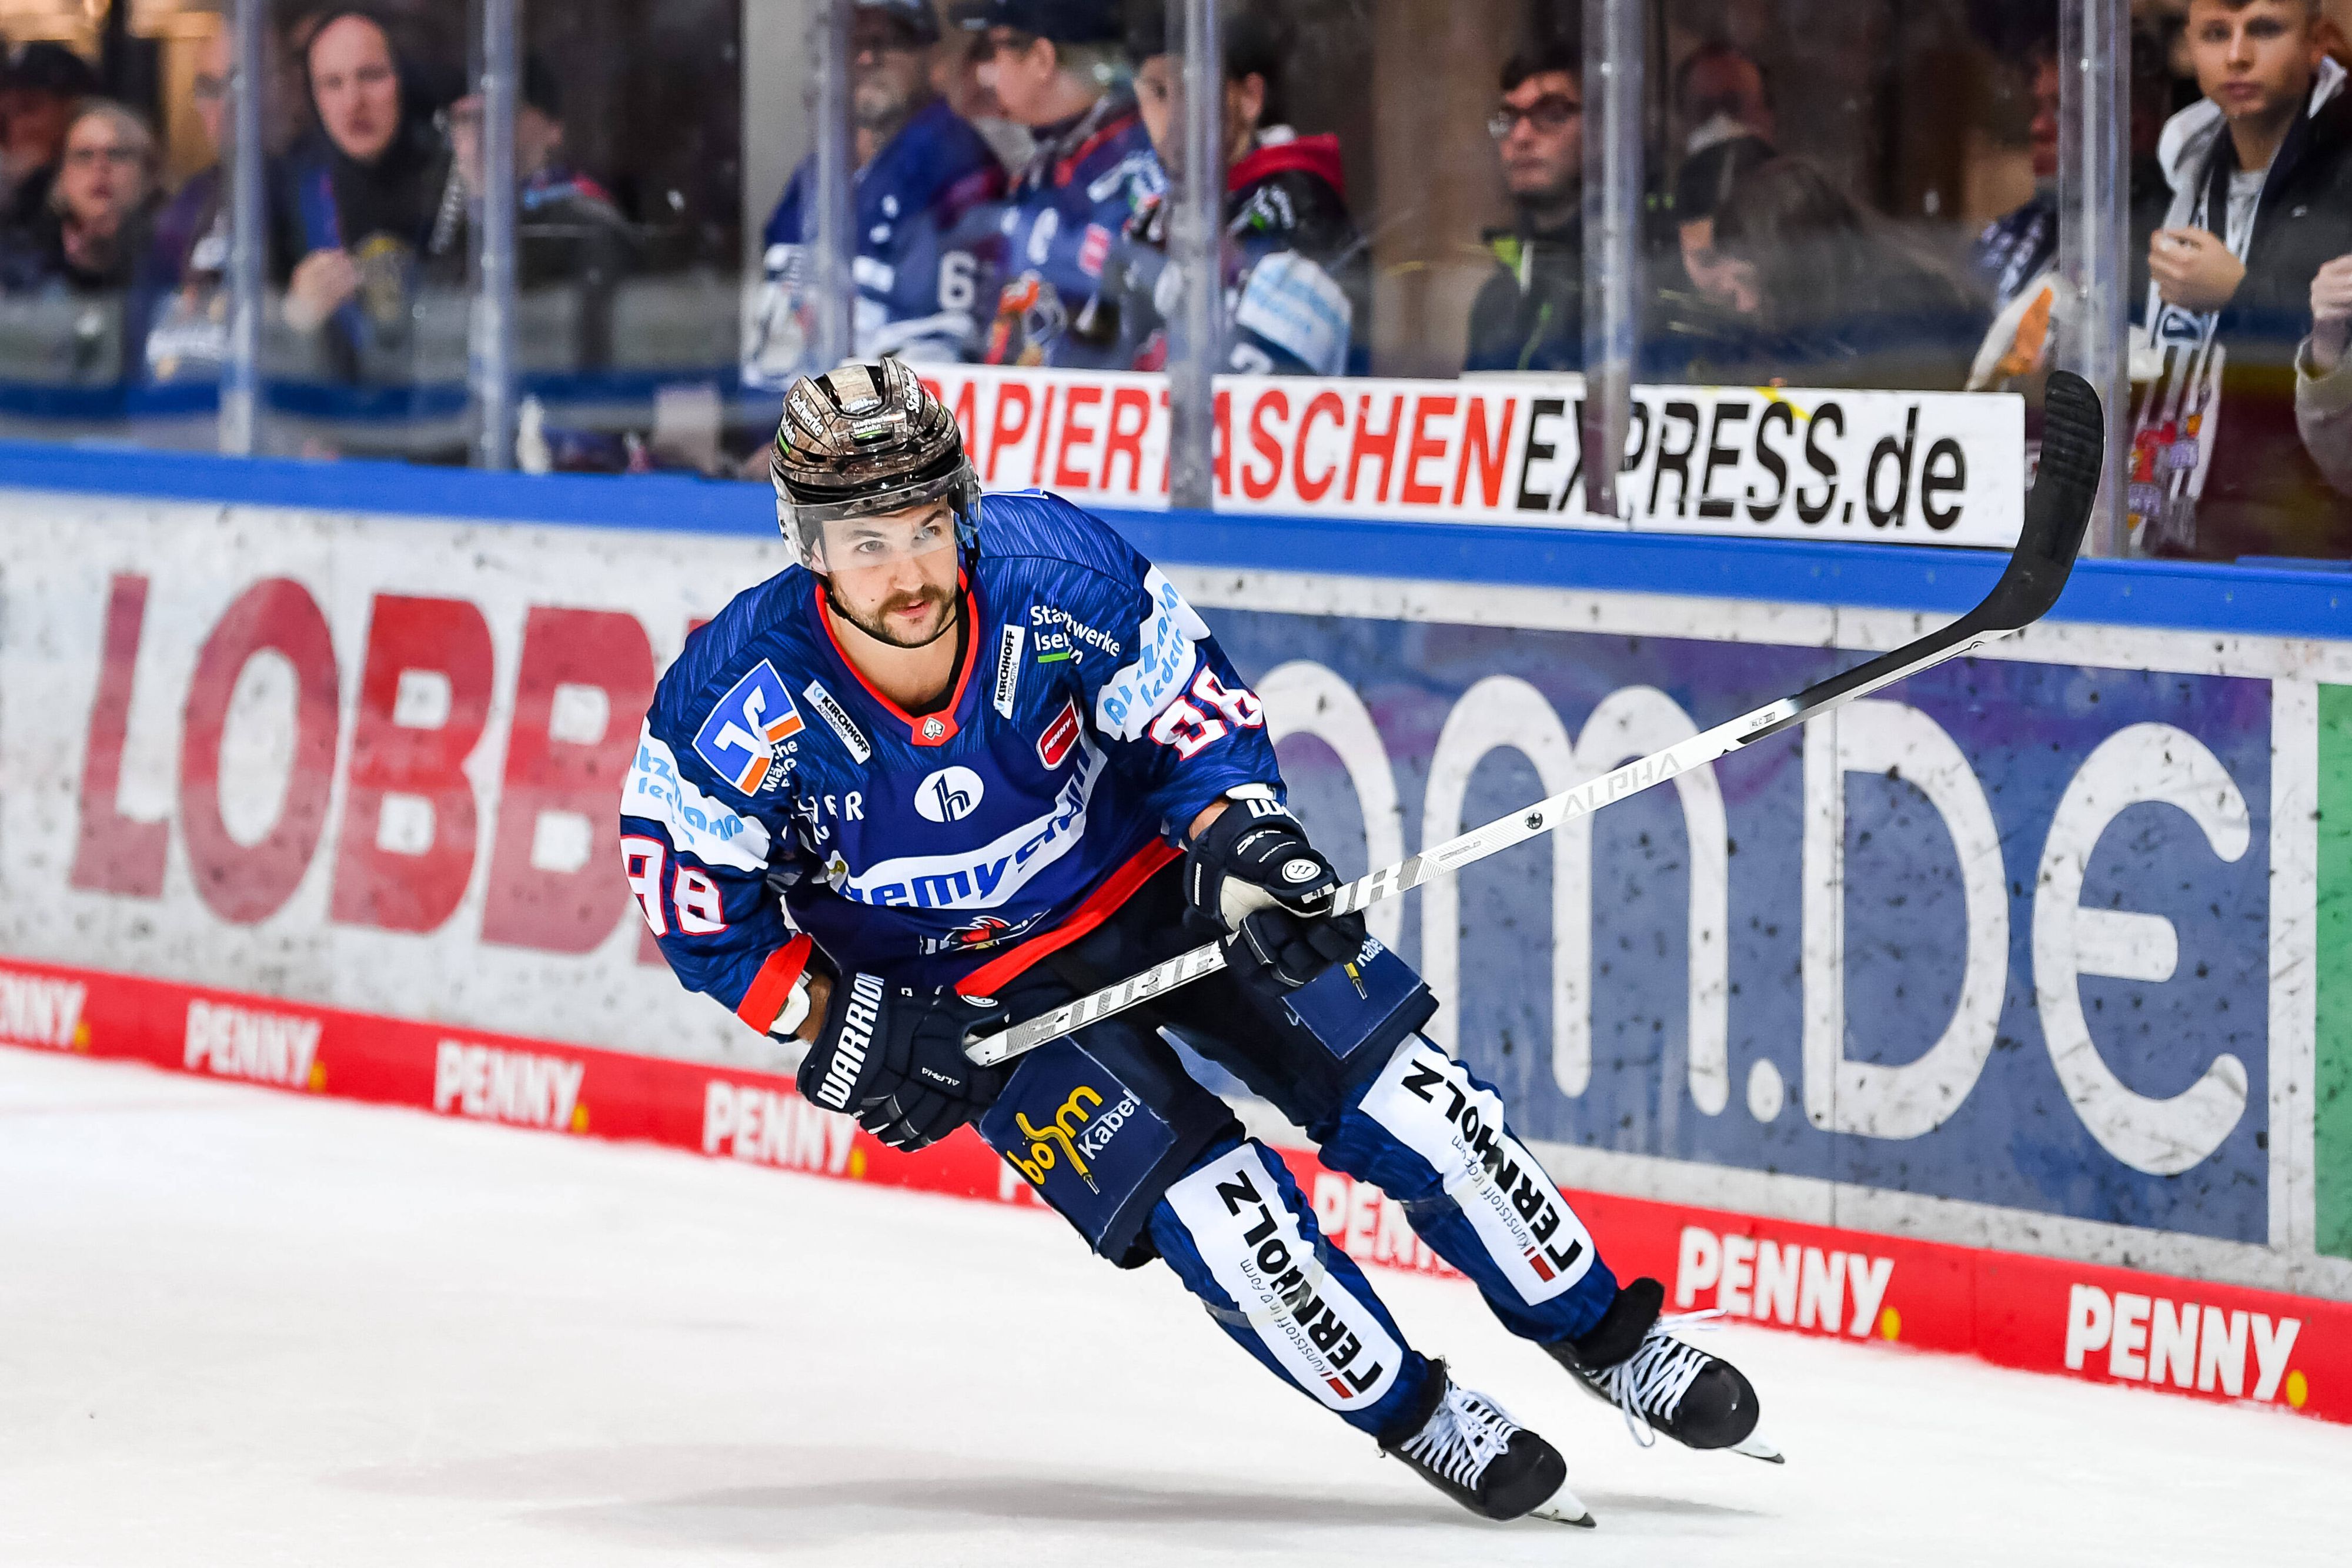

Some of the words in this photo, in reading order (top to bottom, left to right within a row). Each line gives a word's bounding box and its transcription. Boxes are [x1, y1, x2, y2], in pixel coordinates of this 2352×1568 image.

[997, 630, 1015, 703] KIRCHHOFF
[821, 697, 870, 754] KIRCHHOFF
[69, 571, 713, 968] LOBB
[1561, 751, 1683, 821] ALPHA
[1077, 1088, 1143, 1161] Kabel
